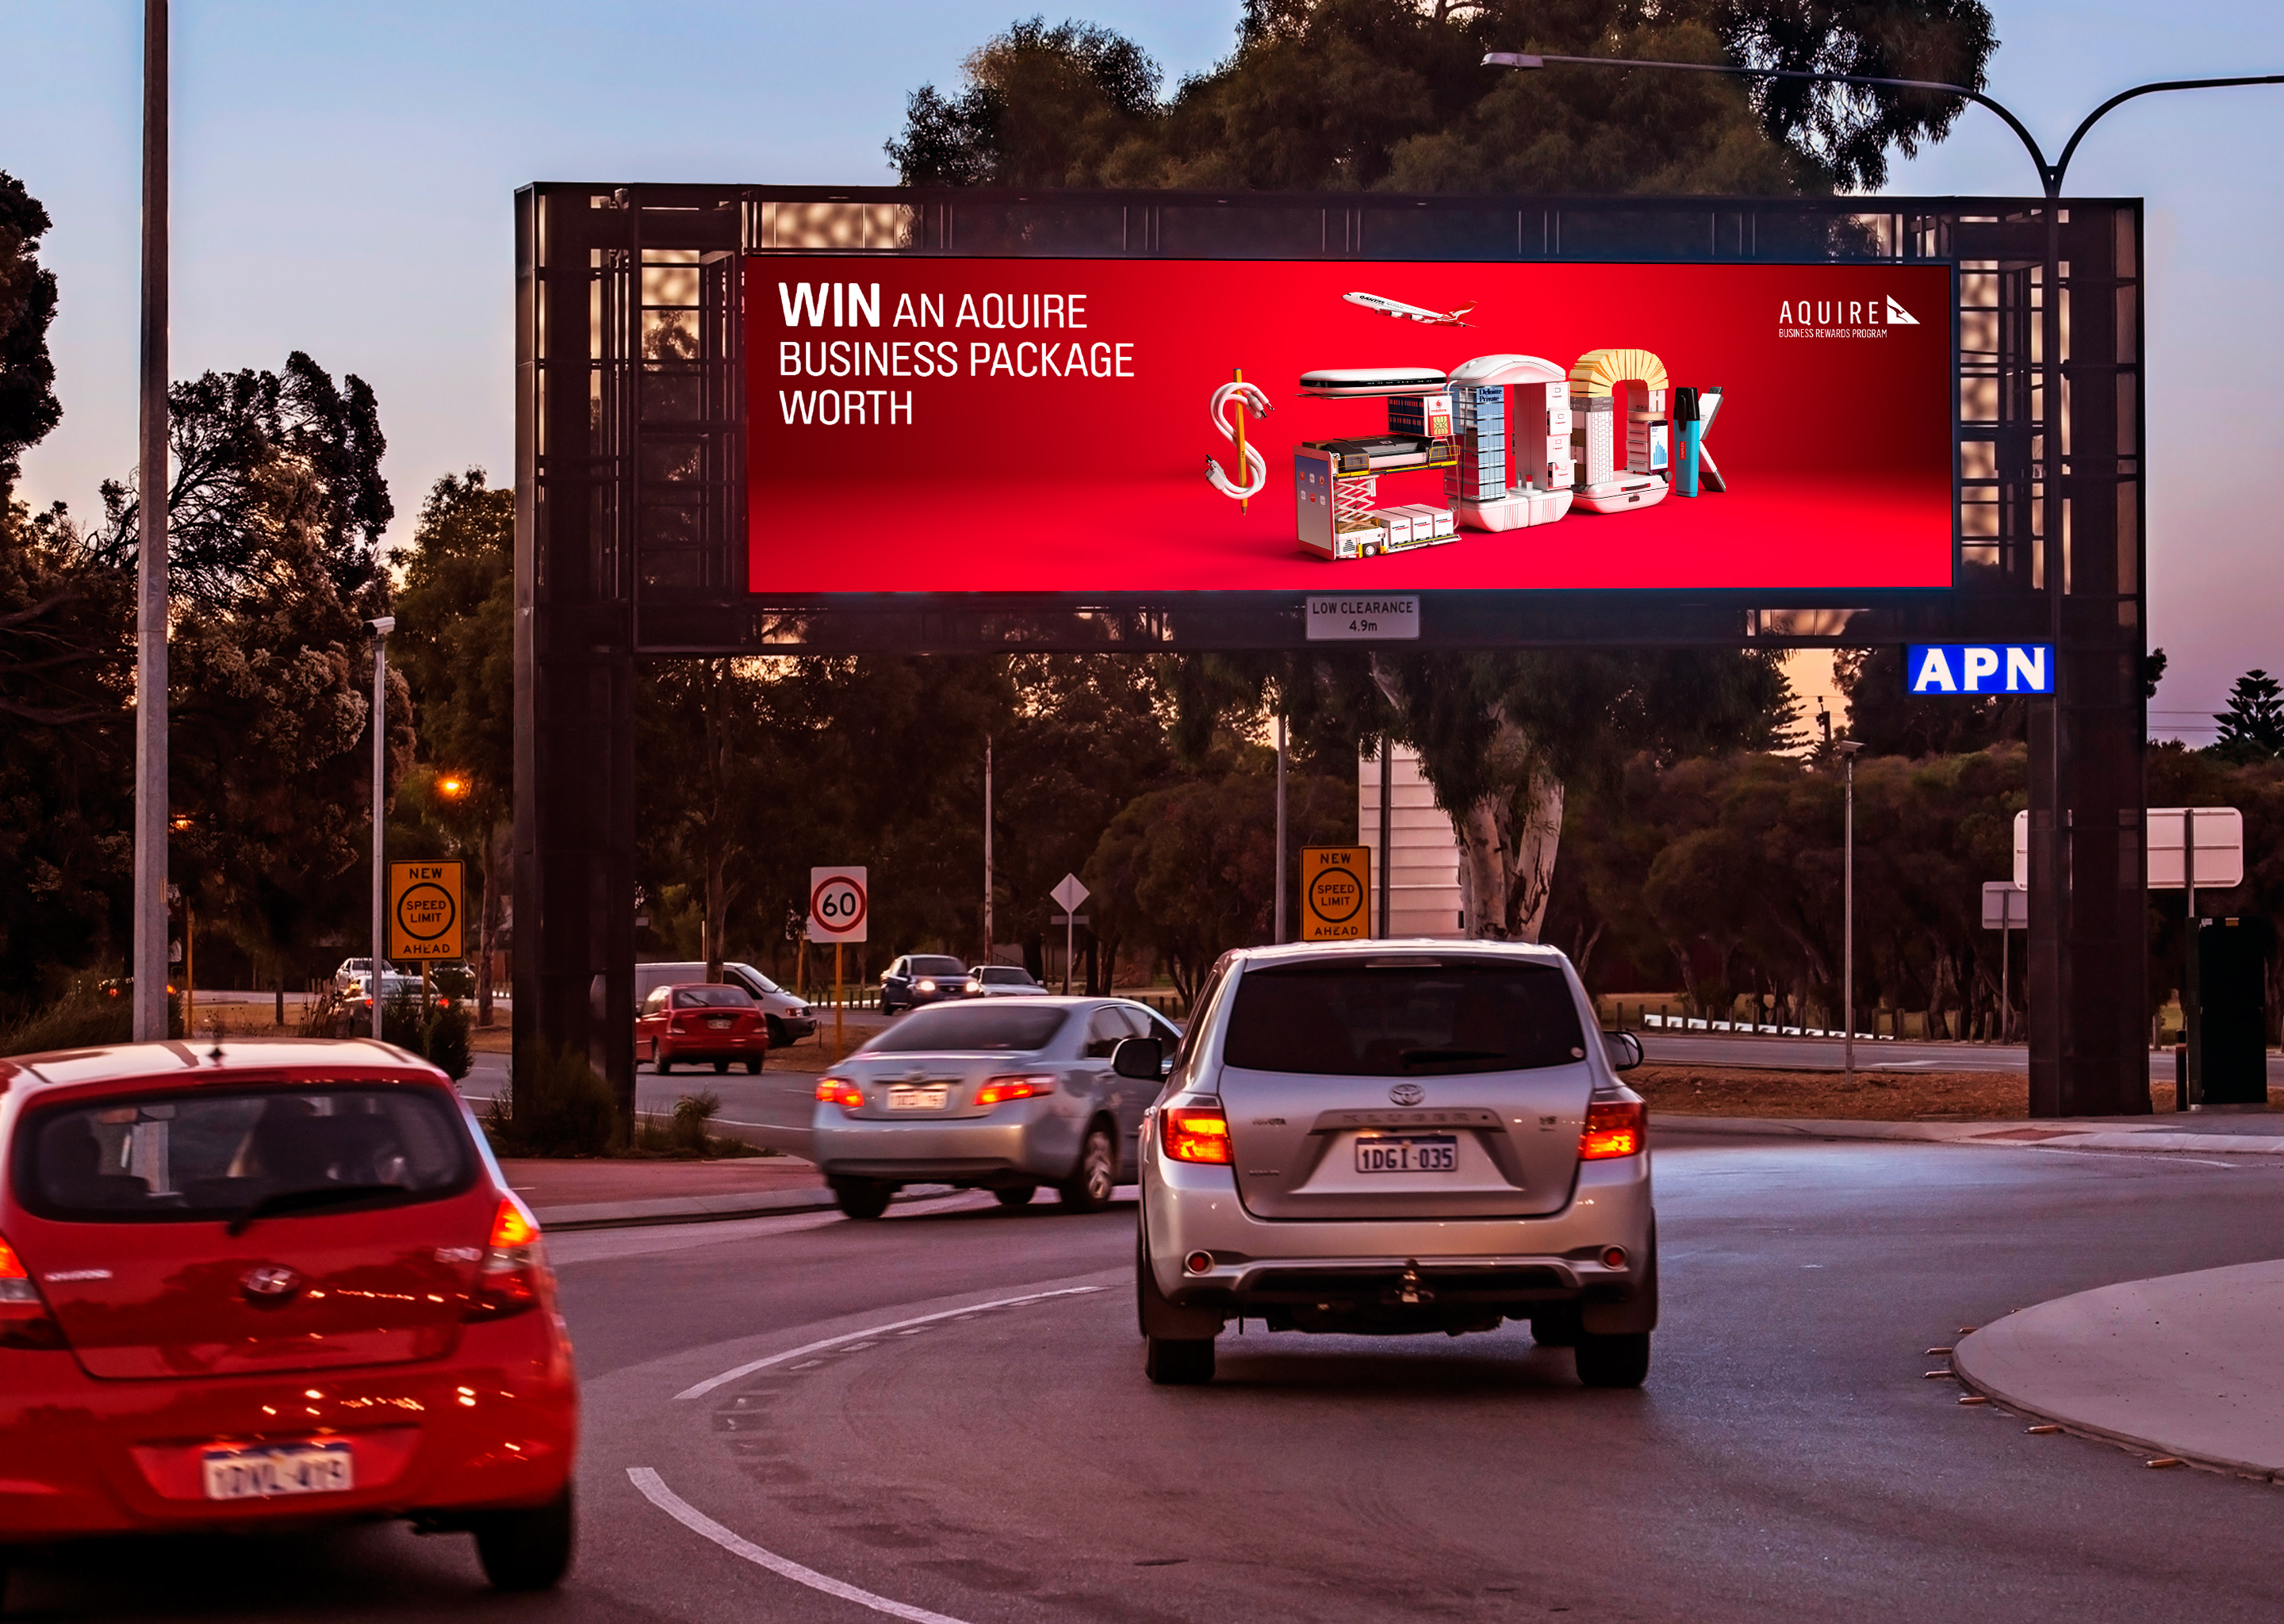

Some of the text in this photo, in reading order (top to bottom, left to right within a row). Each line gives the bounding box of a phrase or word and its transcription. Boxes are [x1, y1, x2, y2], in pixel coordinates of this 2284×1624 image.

[778, 282, 1087, 329] WIN AN AQUIRE
[1779, 300, 1879, 326] AQUIRE
[1779, 328, 1887, 339] BUSINESS REWARDS PROGRAM
[780, 341, 1135, 377] BUSINESS PACKAGE
[779, 389, 912, 426] WORTH
[1313, 601, 1413, 614] LOW CLEARANCE
[1349, 619, 1378, 631] 4.9m
[1913, 647, 2045, 691] APN
[1320, 853, 1351, 864] NEW
[409, 868, 443, 879] NEW
[1317, 884, 1355, 894] SPEED
[406, 900, 446, 910] SPEED
[822, 892, 856, 917] 60
[1321, 897, 1351, 906] LIMIT
[410, 913, 442, 923] LIMIT
[1315, 926, 1359, 936] AHEAD
[403, 944, 450, 954] AHEAD
